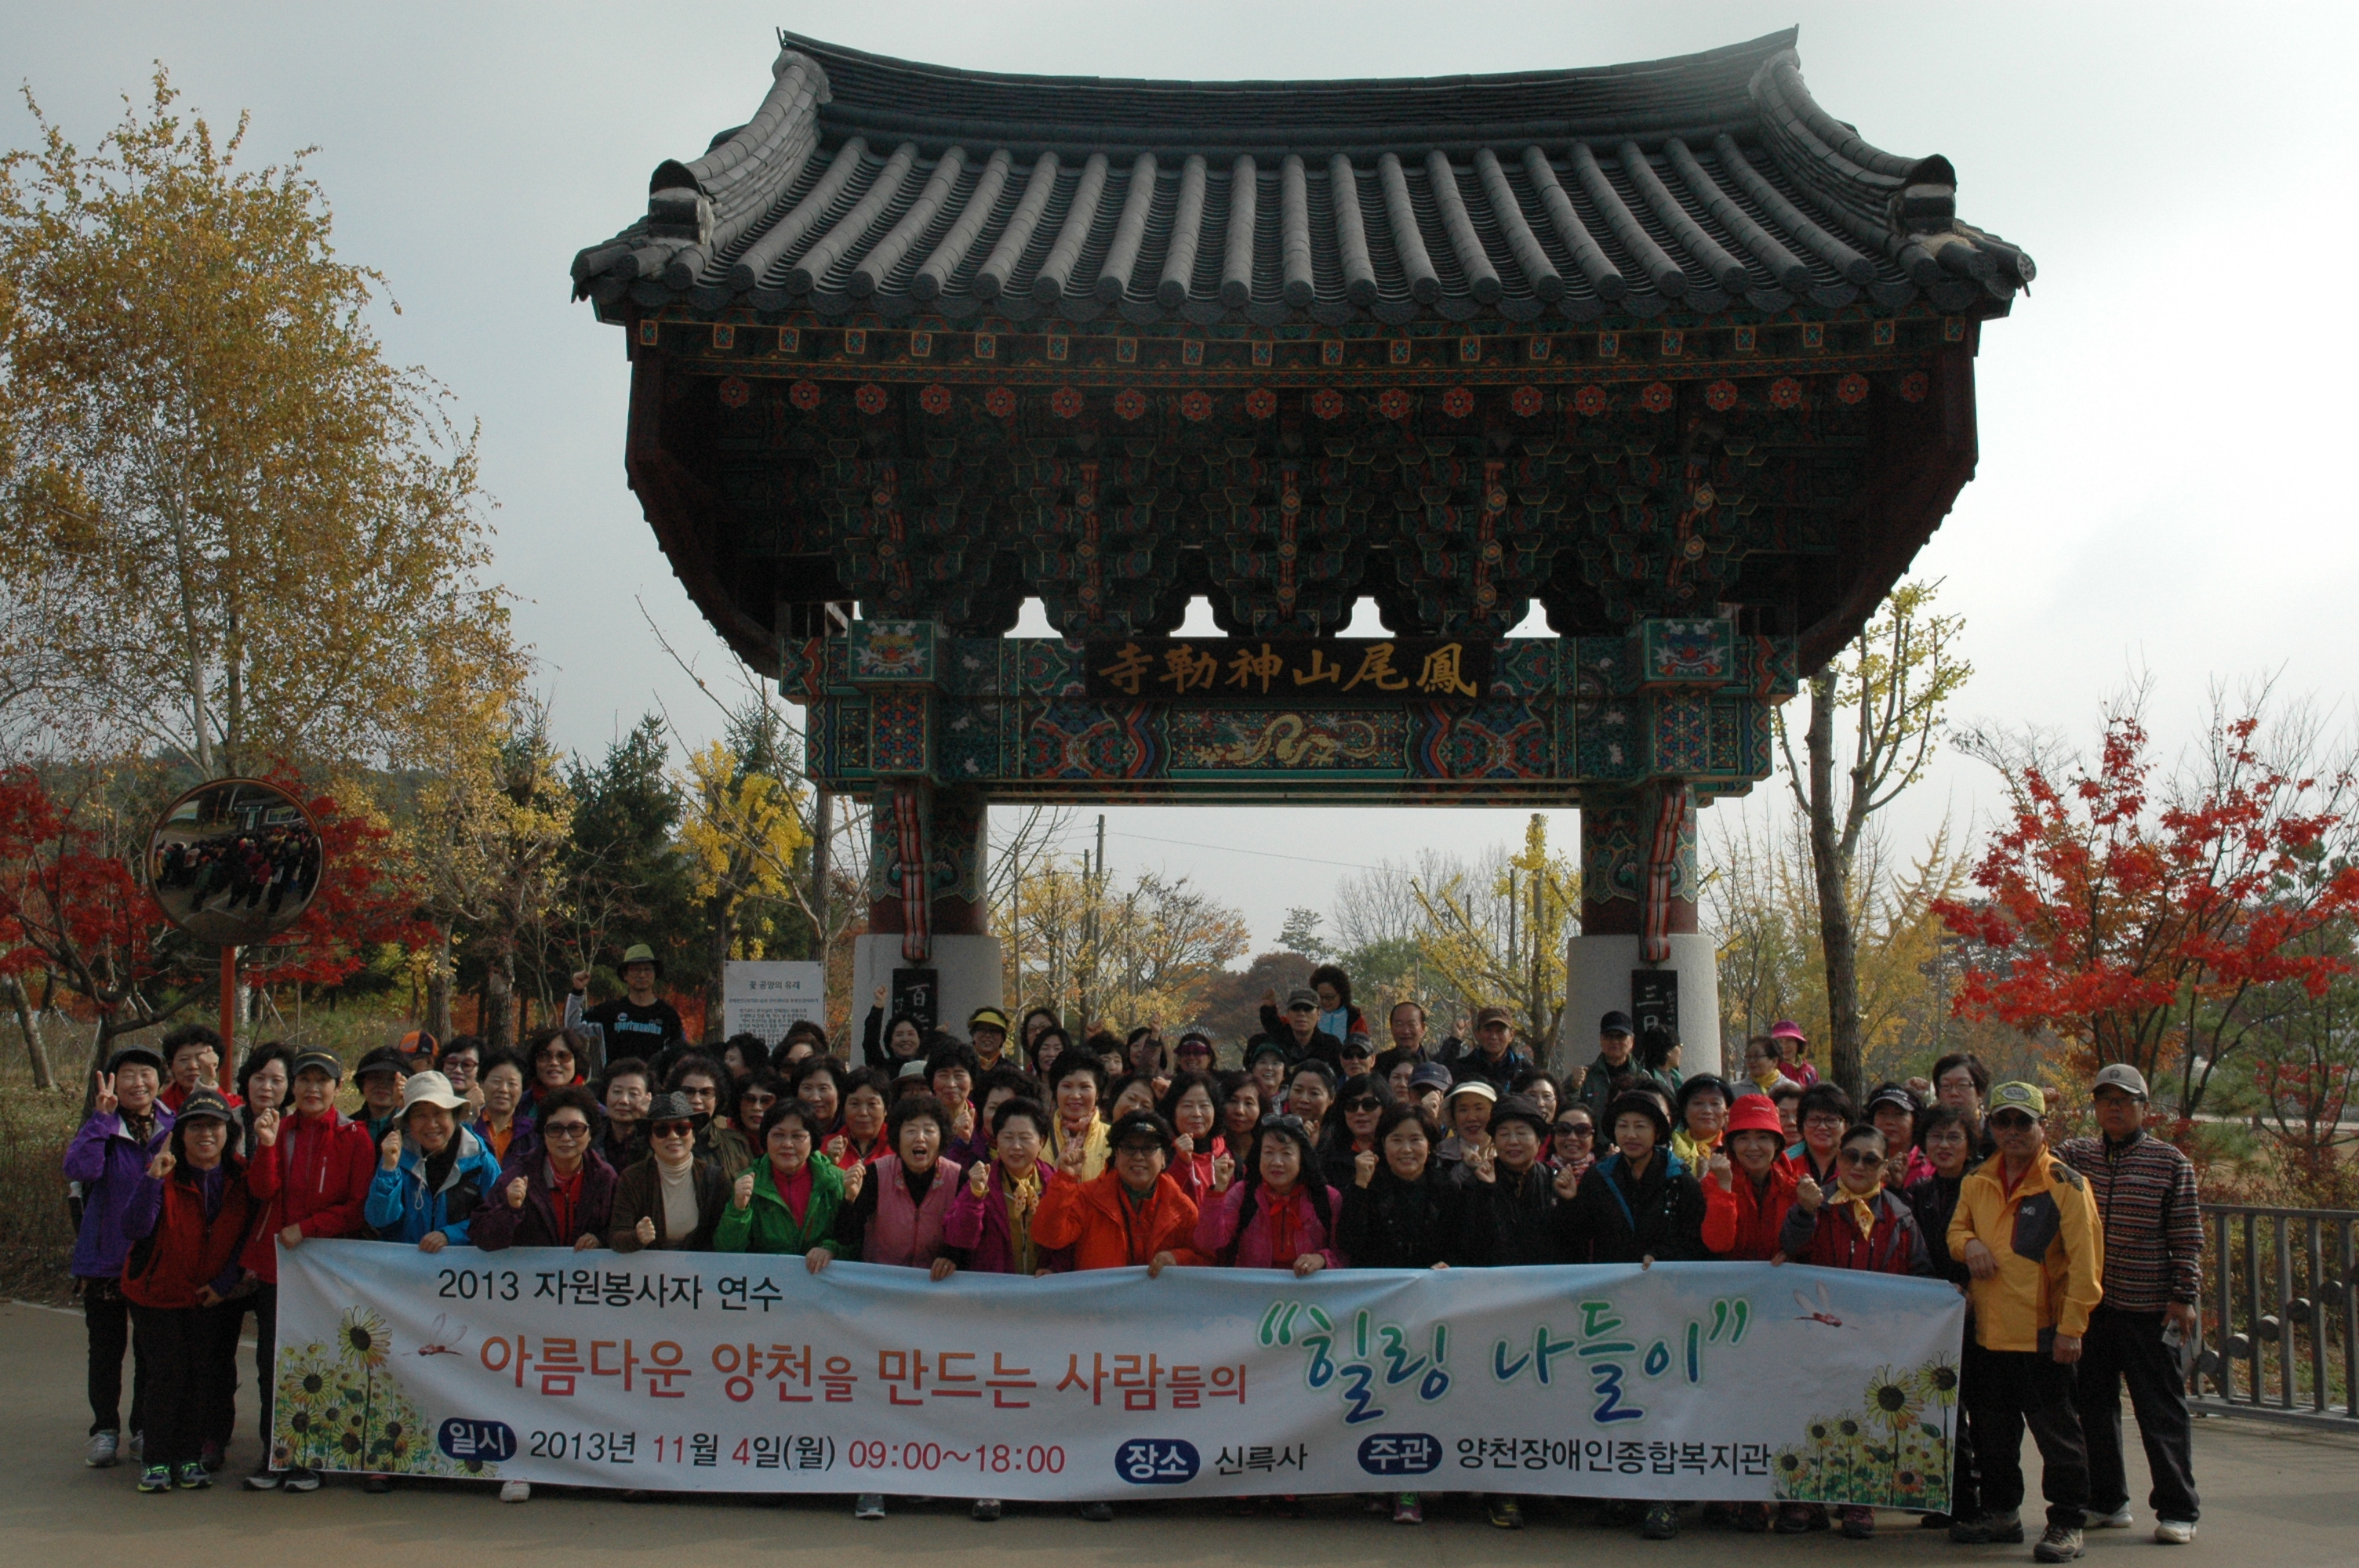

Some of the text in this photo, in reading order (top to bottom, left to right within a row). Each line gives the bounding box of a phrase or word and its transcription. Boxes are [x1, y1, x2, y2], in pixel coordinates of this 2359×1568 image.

[439, 1269, 783, 1312] 2013 자원봉사자 연수
[480, 1334, 692, 1399] 아름다운
[711, 1343, 858, 1403] 양천을
[878, 1349, 1037, 1409] 만드는
[1056, 1352, 1246, 1411] 사람들의
[449, 1421, 1065, 1474] 일시 2013년 11월 4일(월) 09:00~18:00
[1126, 1442, 1308, 1479] 장소 신륵사
[1368, 1436, 1772, 1475] 주관 양천장애인종합복지관
